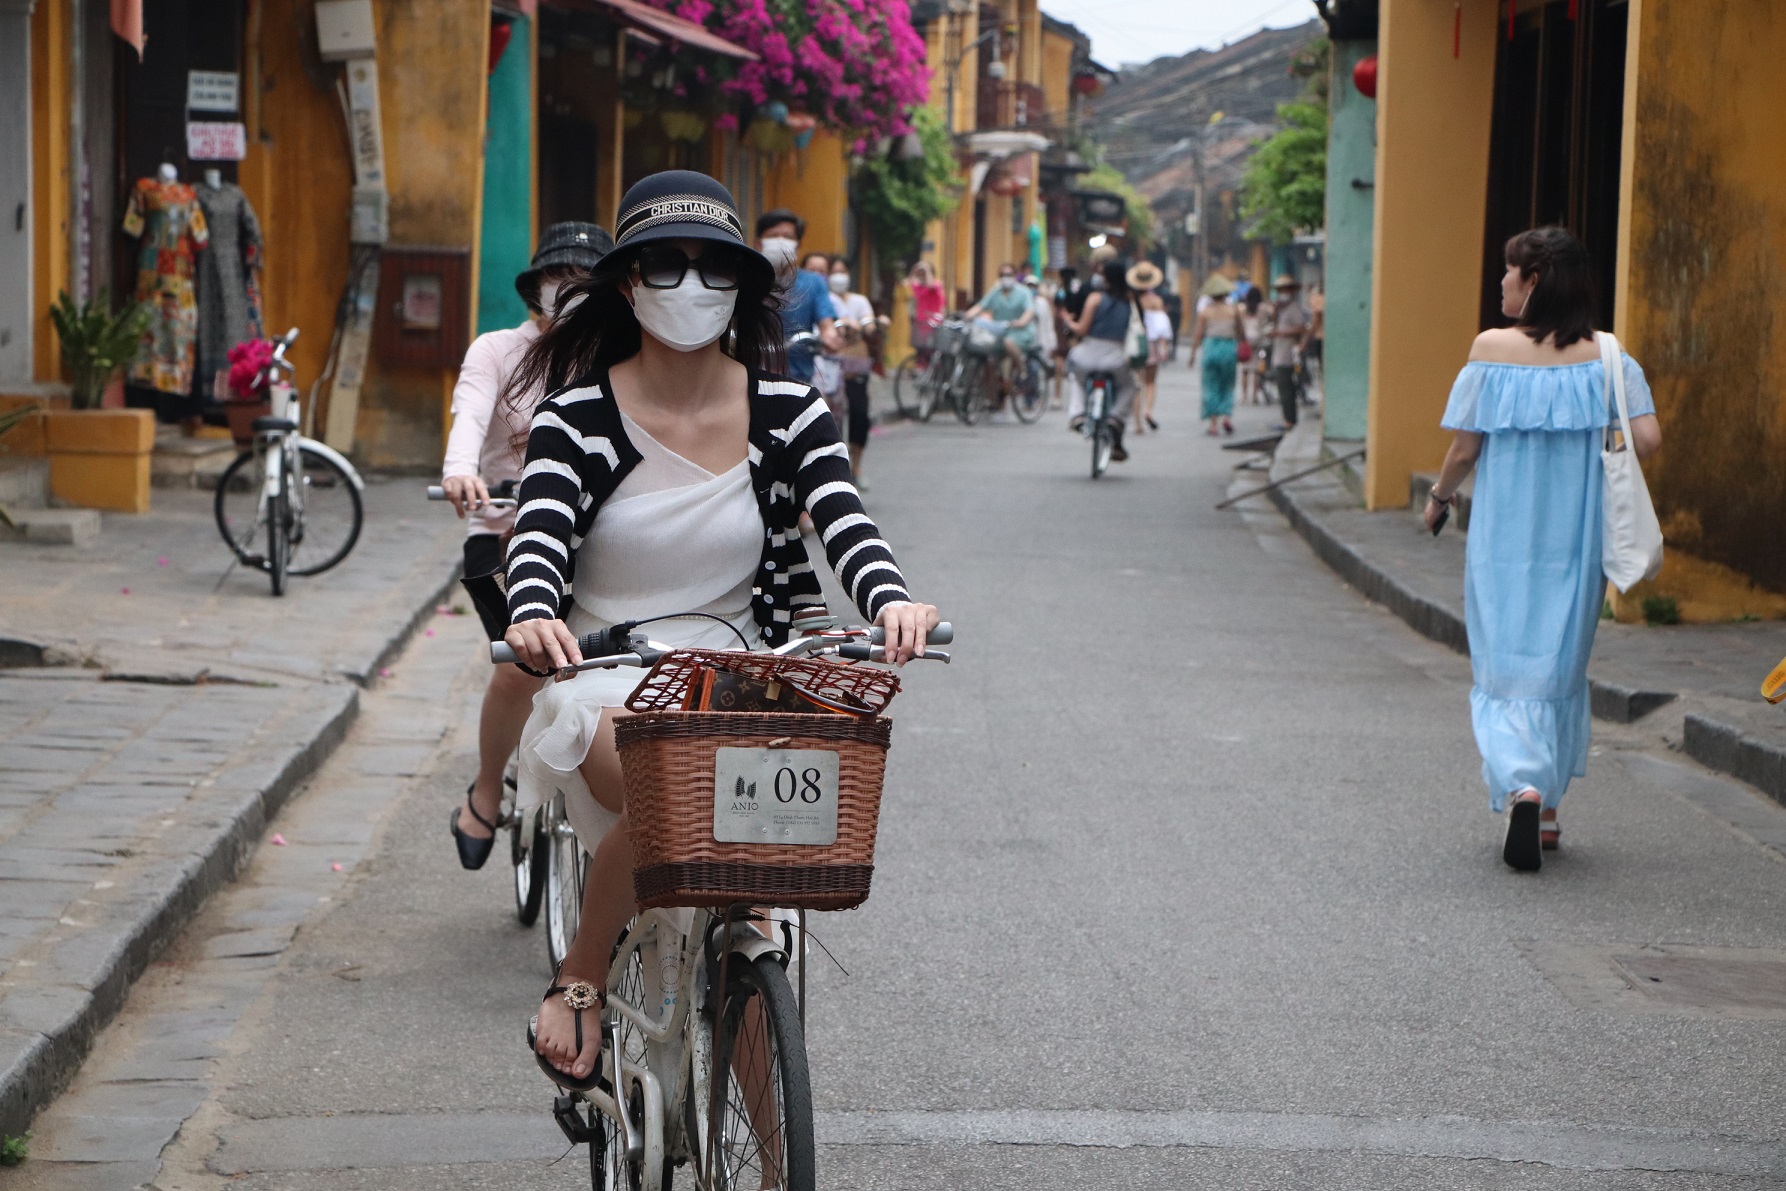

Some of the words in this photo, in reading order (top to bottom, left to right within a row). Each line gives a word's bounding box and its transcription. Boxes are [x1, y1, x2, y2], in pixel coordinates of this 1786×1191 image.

[651, 202, 708, 216] CHRISTIAN
[708, 207, 729, 222] DIOR
[774, 767, 821, 803] 08
[731, 802, 758, 810] ANIO
